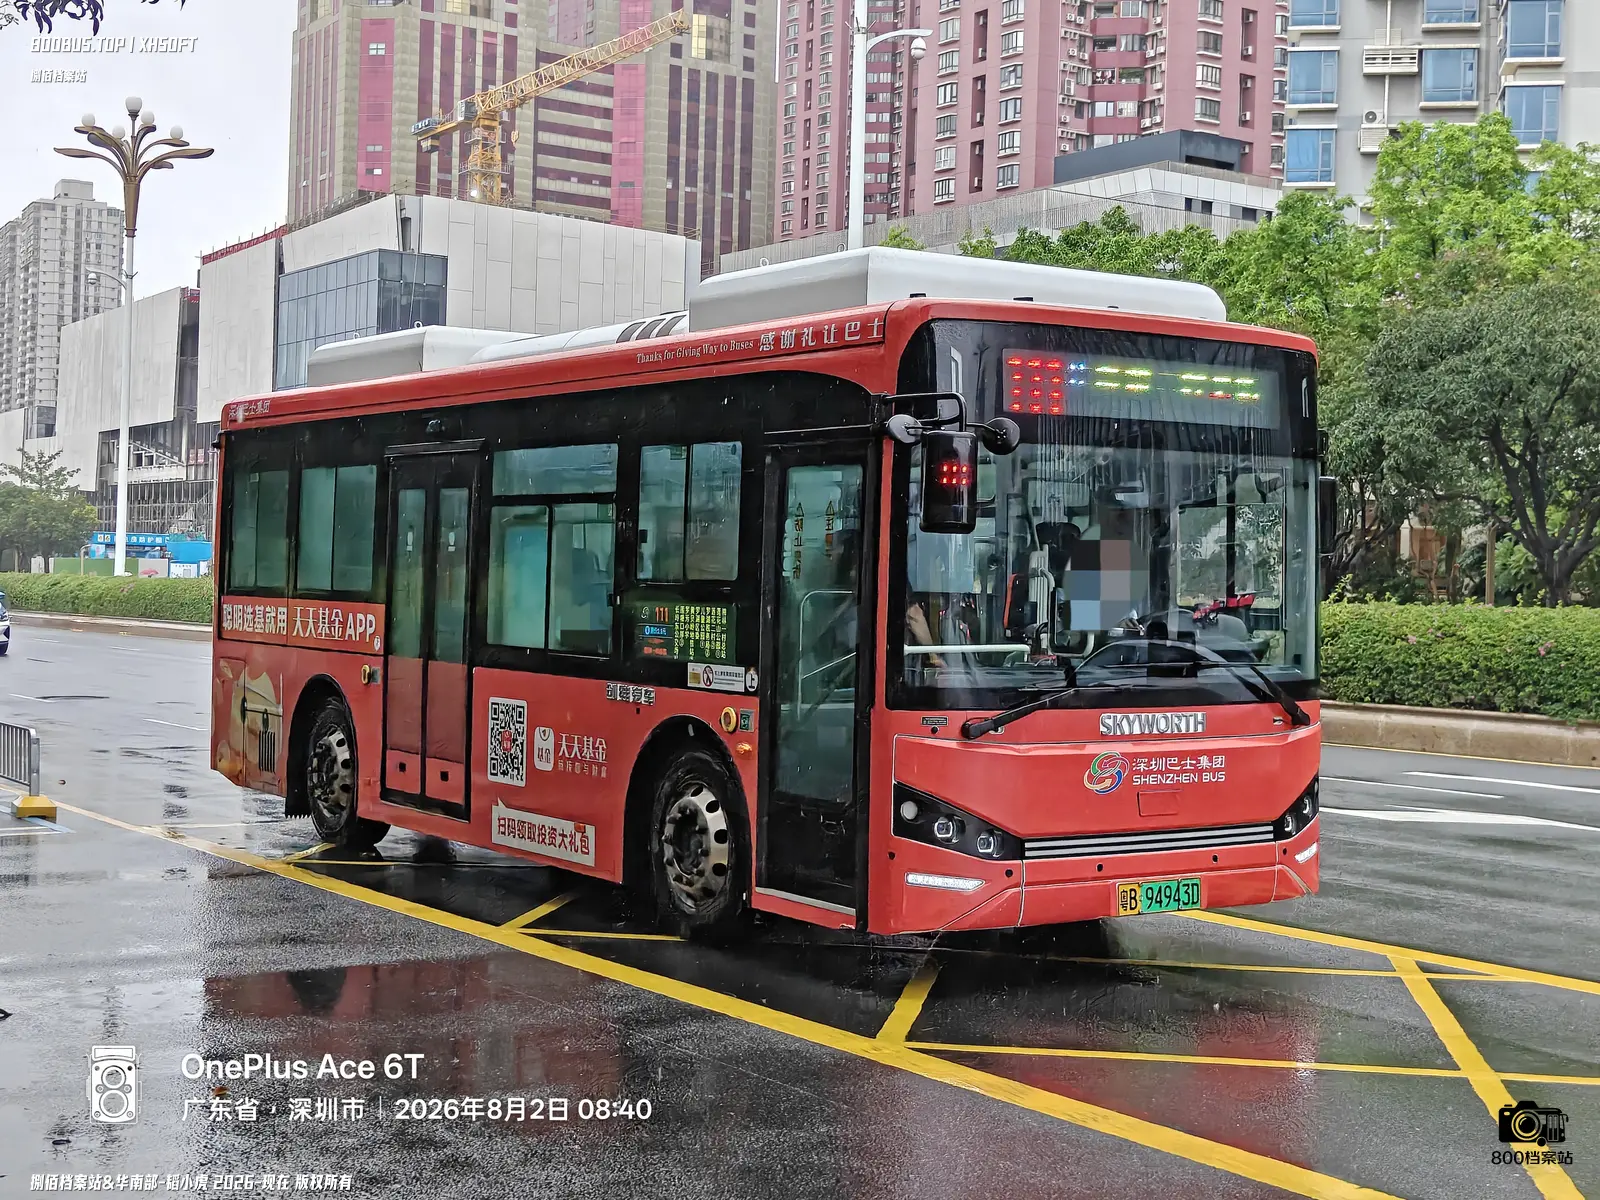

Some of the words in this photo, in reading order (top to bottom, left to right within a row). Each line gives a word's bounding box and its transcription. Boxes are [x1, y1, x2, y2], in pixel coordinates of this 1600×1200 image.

[759, 318, 885, 352] 感谢礼让巴士
[636, 353, 662, 363] Thanks
[664, 350, 675, 360] for
[676, 346, 701, 358] Giving
[702, 344, 718, 355] Way
[720, 342, 728, 352] to
[730, 340, 754, 351] Buses
[1100, 712, 1207, 736] SKYWORTH
[557, 732, 608, 764] 天天基金
[1132, 755, 1226, 772] 深圳巴士集团
[1132, 773, 1199, 785] SHENZHEN
[1202, 771, 1226, 783] BUS
[497, 816, 590, 856] 扫码领取投资大礼包
